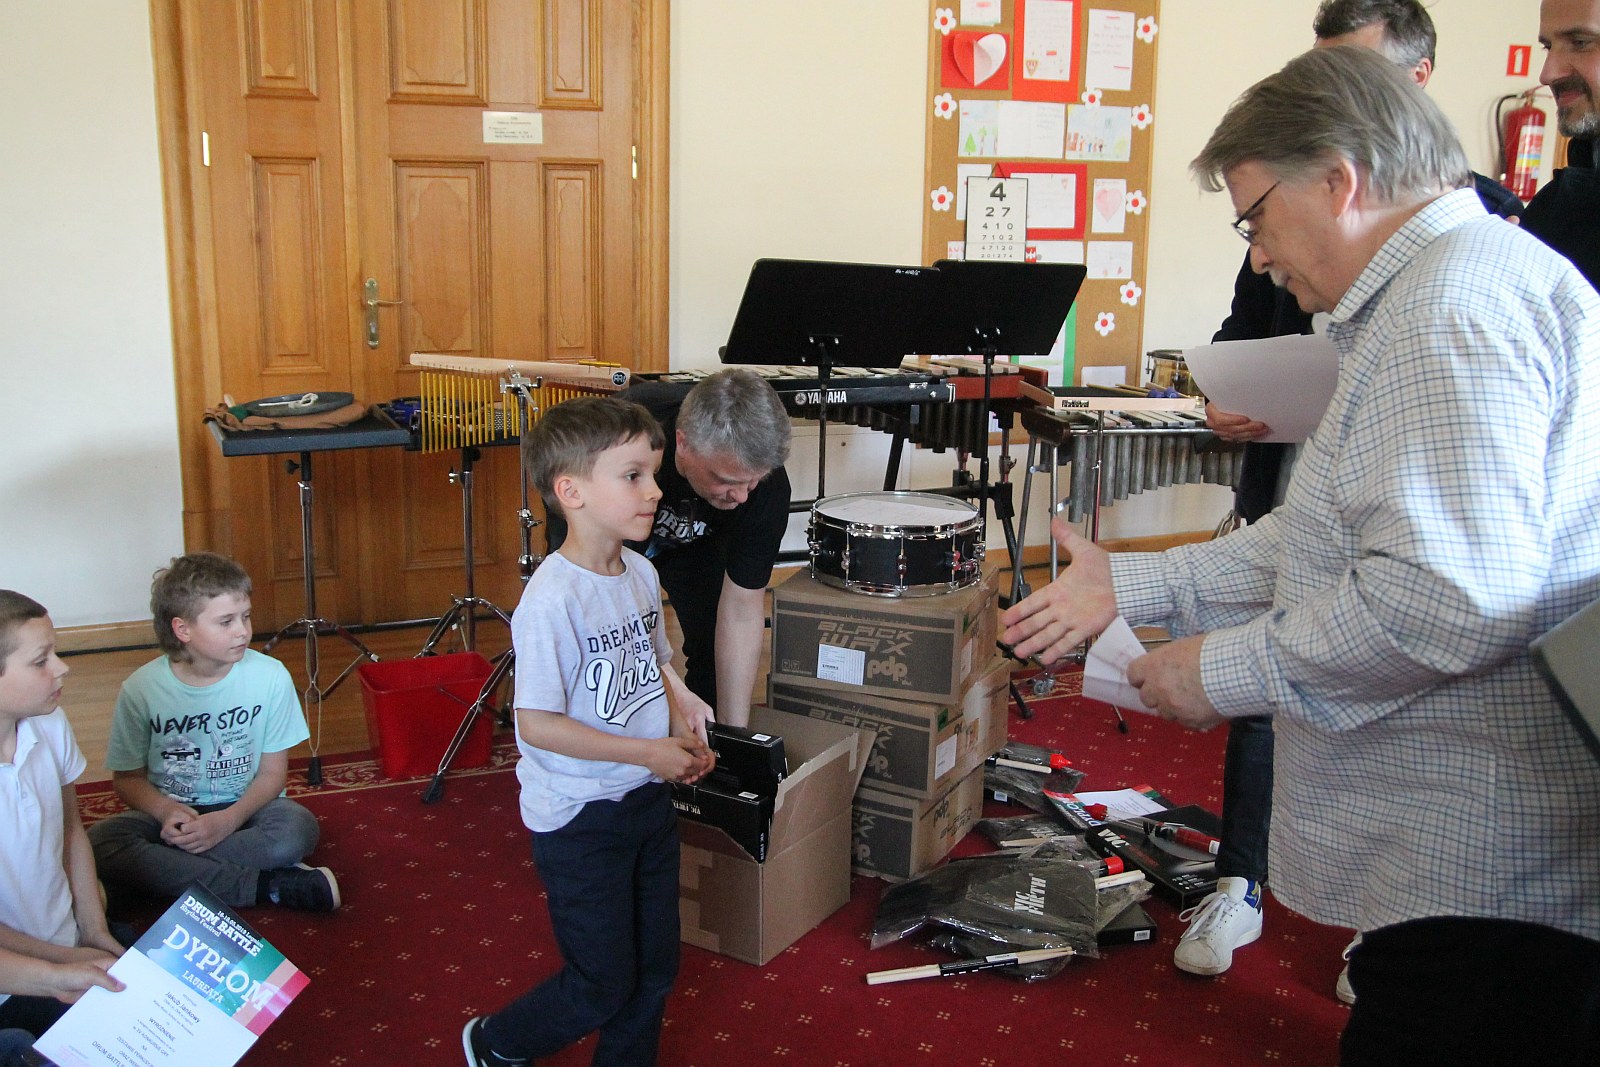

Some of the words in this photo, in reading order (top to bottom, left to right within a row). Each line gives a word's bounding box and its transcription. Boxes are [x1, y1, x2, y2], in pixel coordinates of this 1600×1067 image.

[990, 182, 1006, 201] 4
[587, 620, 641, 653] DREAM
[818, 621, 914, 641] BLACK
[820, 632, 912, 656] WAX
[867, 656, 908, 681] pdp
[149, 713, 211, 735] NEVER
[216, 705, 262, 729] STOP
[206, 759, 231, 770] SKATE
[1097, 829, 1131, 848] VIC
[1014, 891, 1030, 911] VIC
[1028, 877, 1046, 916] FIRTH
[180, 903, 201, 922] Rhythm
[200, 918, 222, 937] Festival
[184, 895, 220, 926] DRUM
[217, 920, 261, 957] BATTLE
[162, 924, 277, 1011] DYPLOM
[182, 970, 224, 1004] LAUREATA
